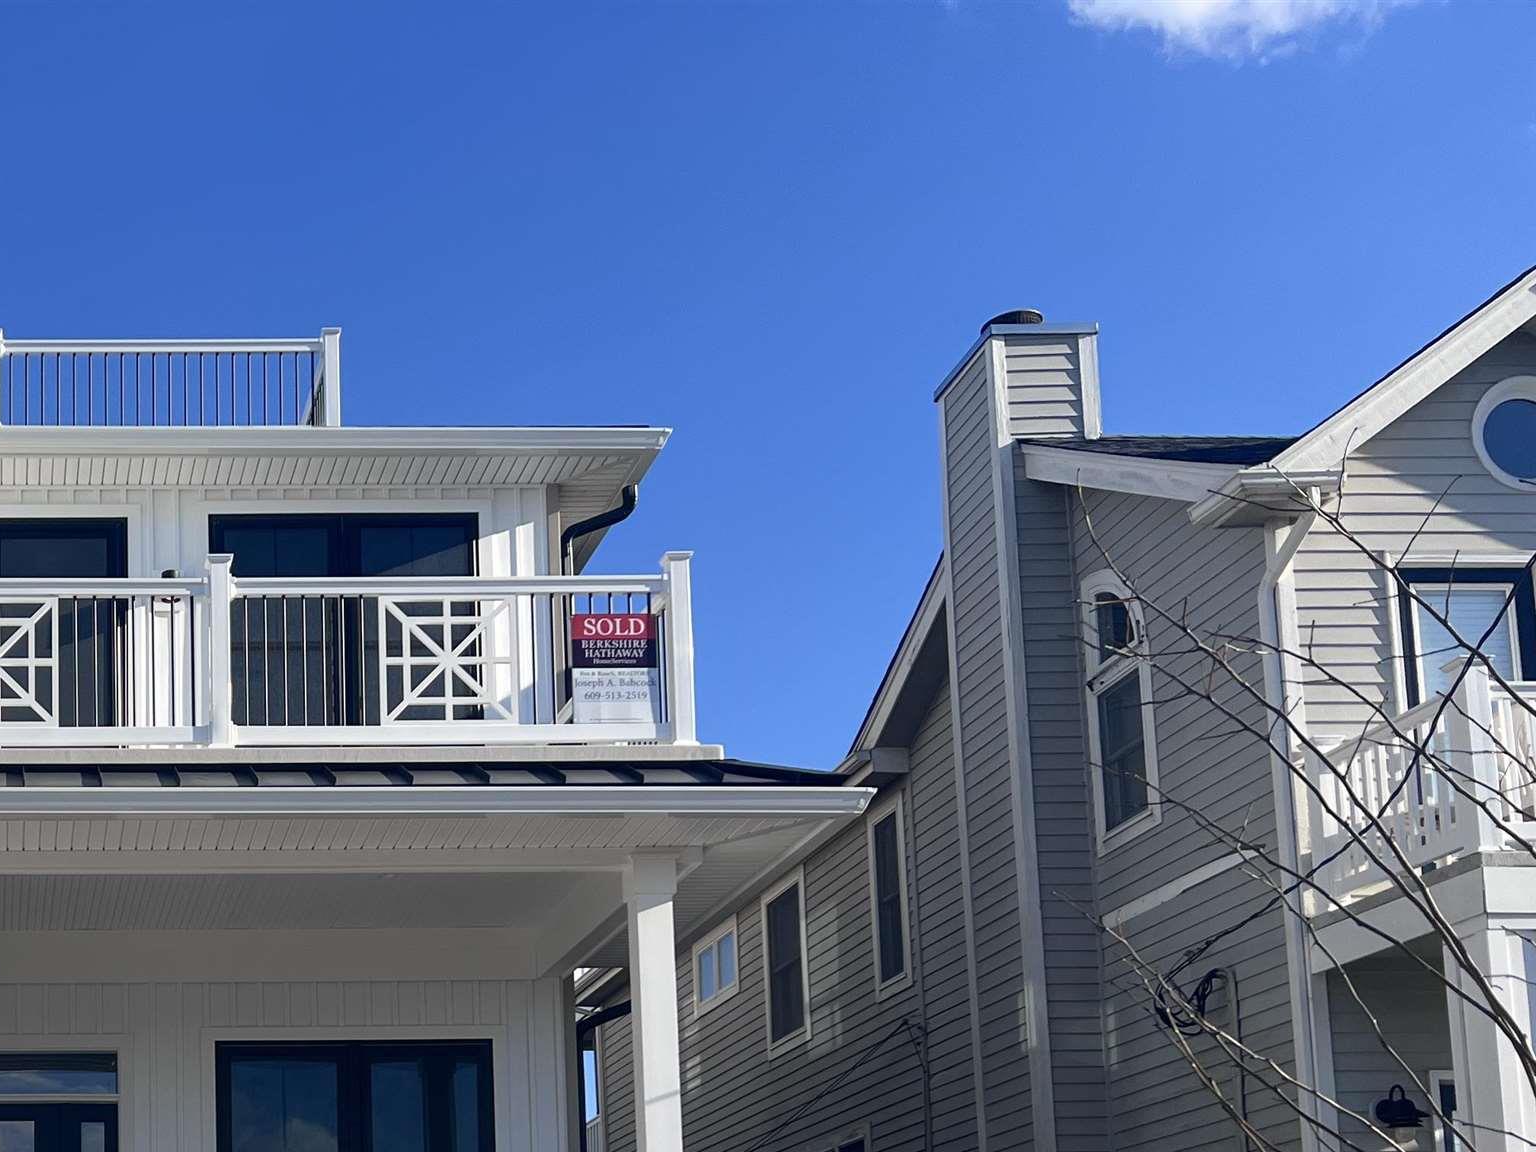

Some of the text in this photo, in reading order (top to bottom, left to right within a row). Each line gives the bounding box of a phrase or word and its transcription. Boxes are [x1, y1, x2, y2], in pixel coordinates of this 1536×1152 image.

[584, 618, 645, 636] SOLD
[582, 640, 648, 648] BERKSHIRE
[585, 649, 645, 658] HATHAWAY
[575, 679, 604, 688] Joseph
